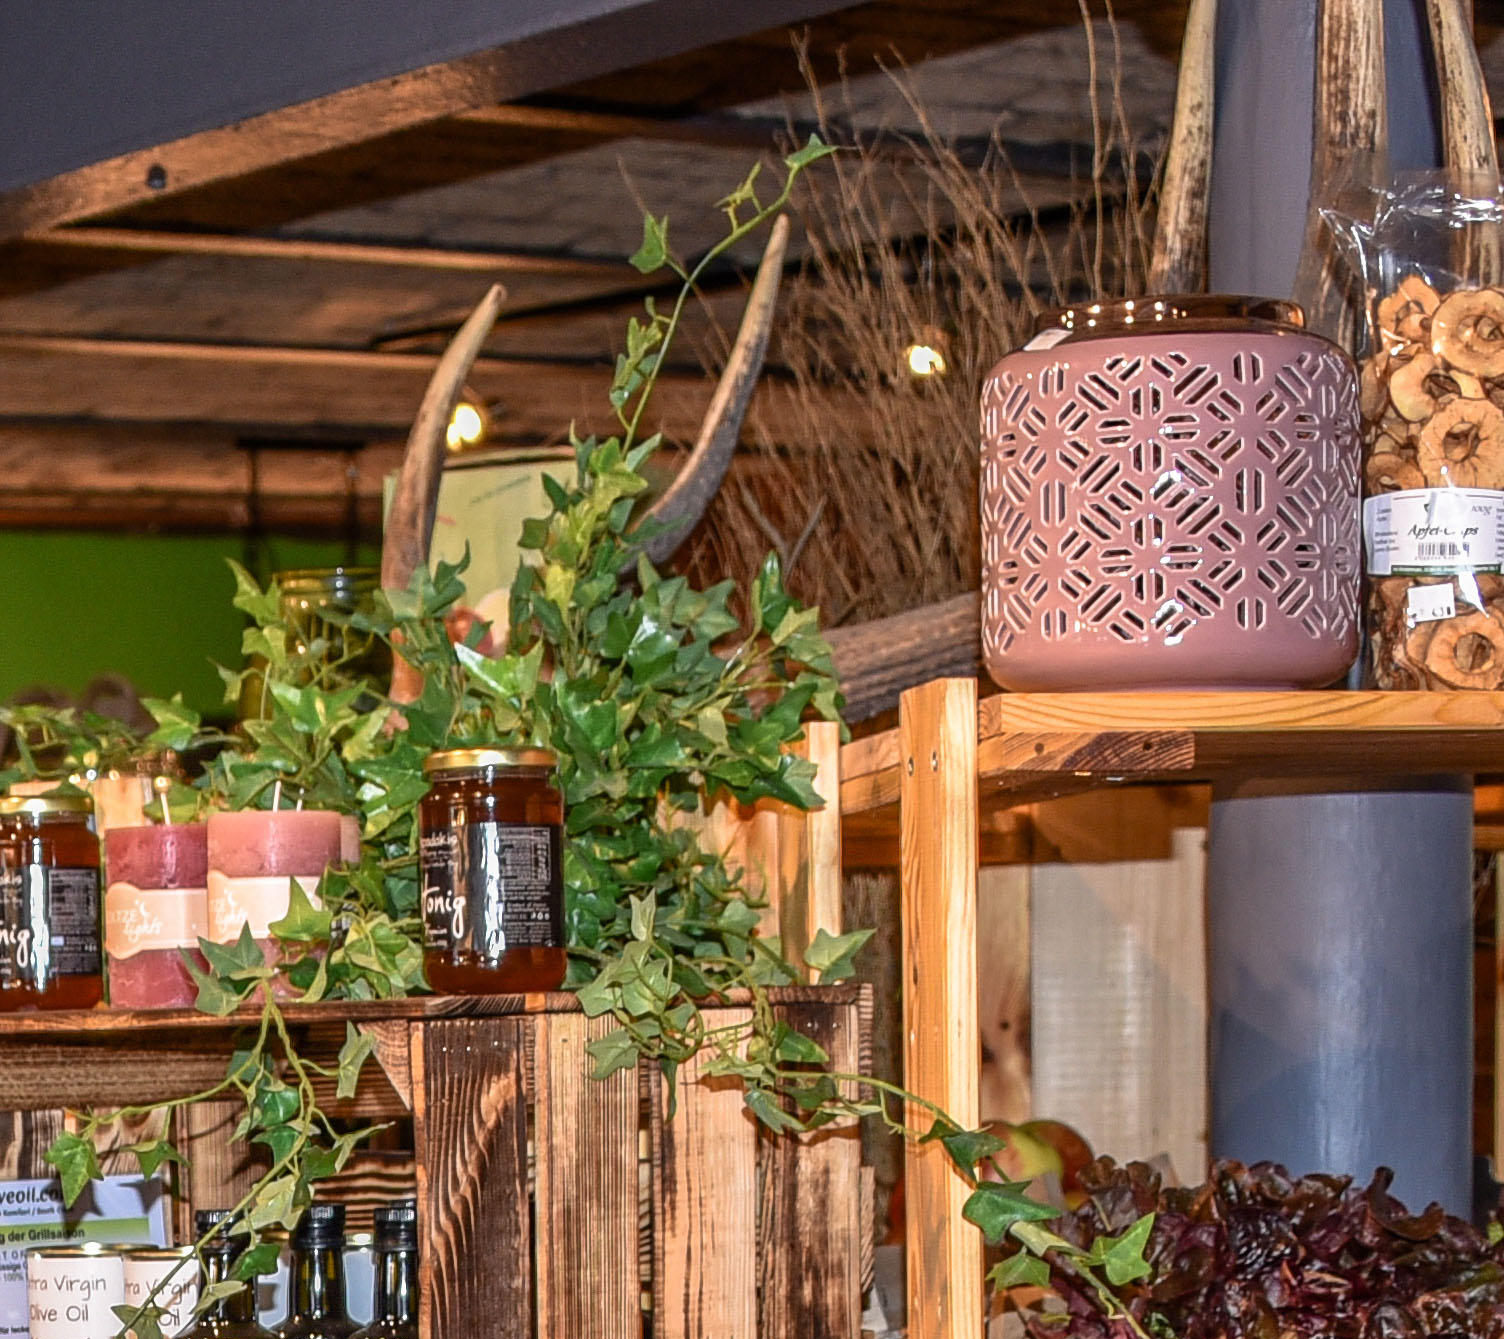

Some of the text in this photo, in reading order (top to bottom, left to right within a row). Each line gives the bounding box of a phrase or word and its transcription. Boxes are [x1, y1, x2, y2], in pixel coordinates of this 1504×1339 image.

[8, 1230, 26, 1242] der
[54, 1276, 107, 1302] Virgin
[66, 1305, 89, 1322] Oil
